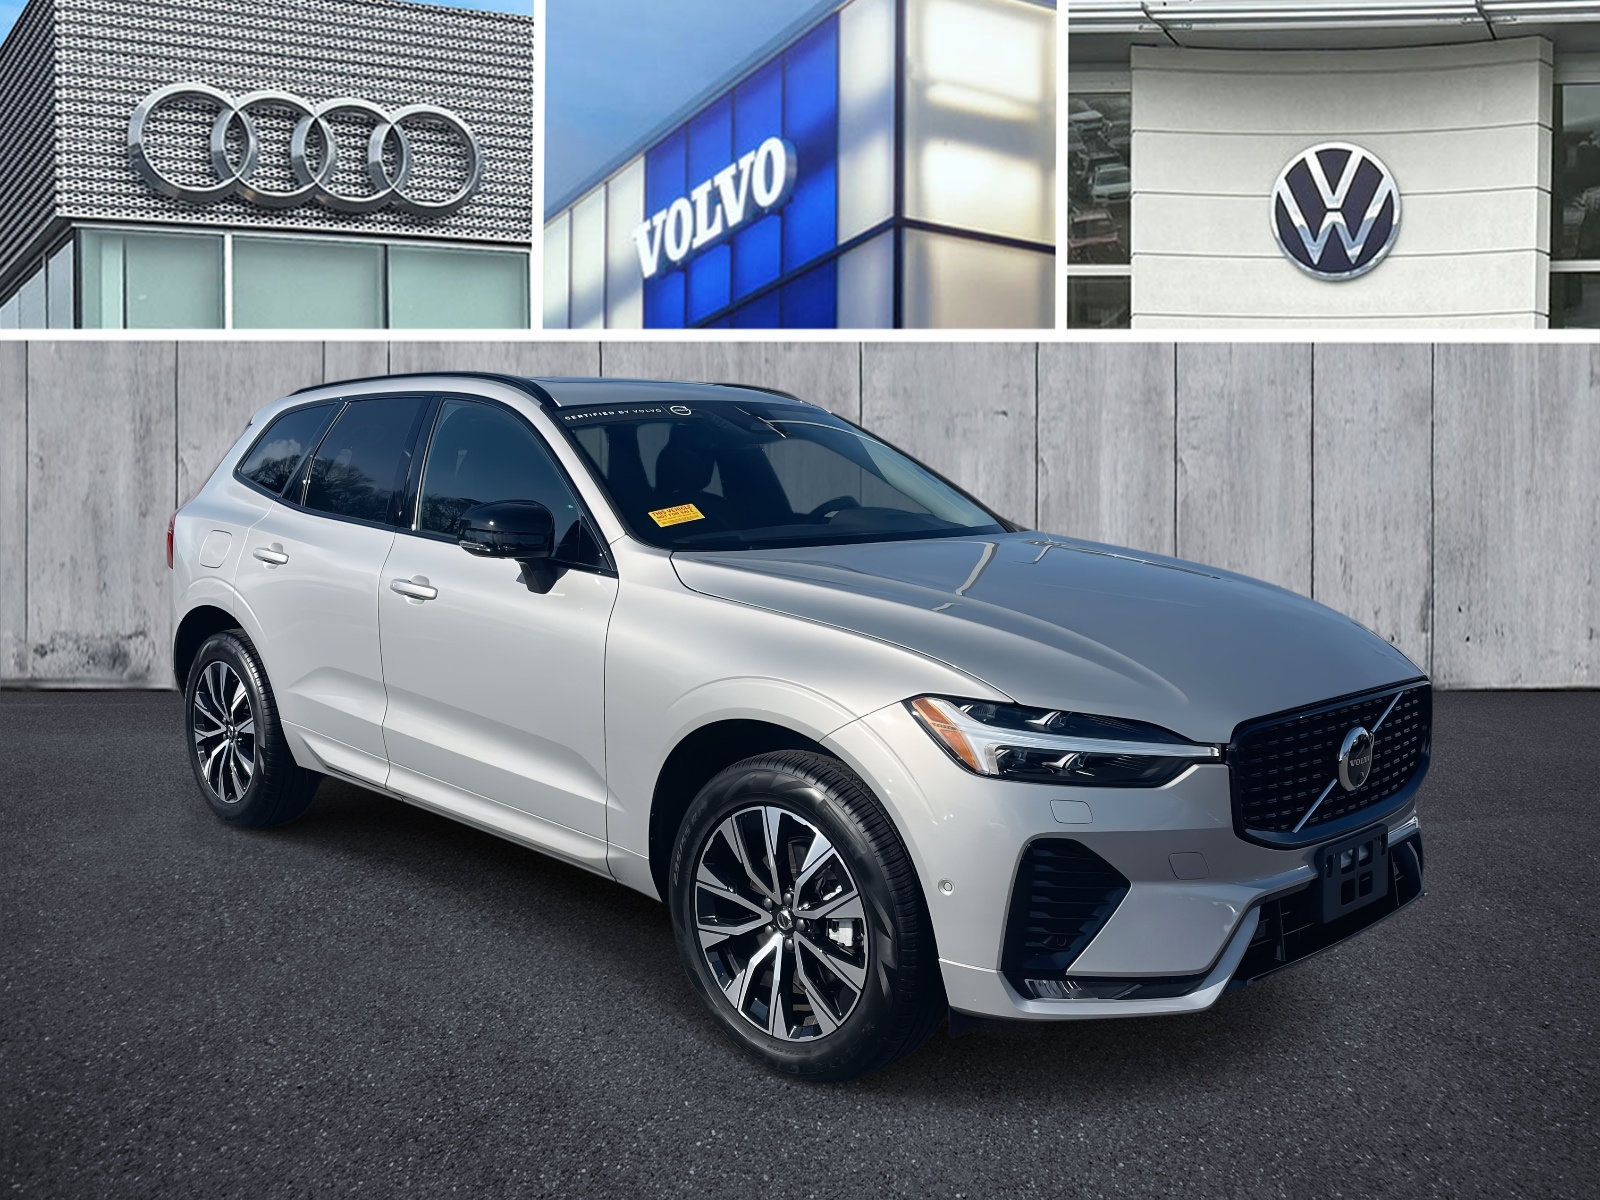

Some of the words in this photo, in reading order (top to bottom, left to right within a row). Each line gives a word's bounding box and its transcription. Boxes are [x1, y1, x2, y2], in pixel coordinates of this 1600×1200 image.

[632, 137, 790, 279] VOLVO
[1273, 146, 1396, 270] VW
[564, 411, 615, 420] CERTIFIED
[667, 505, 691, 513] VEHICLE
[1349, 754, 1371, 767] VOLV
